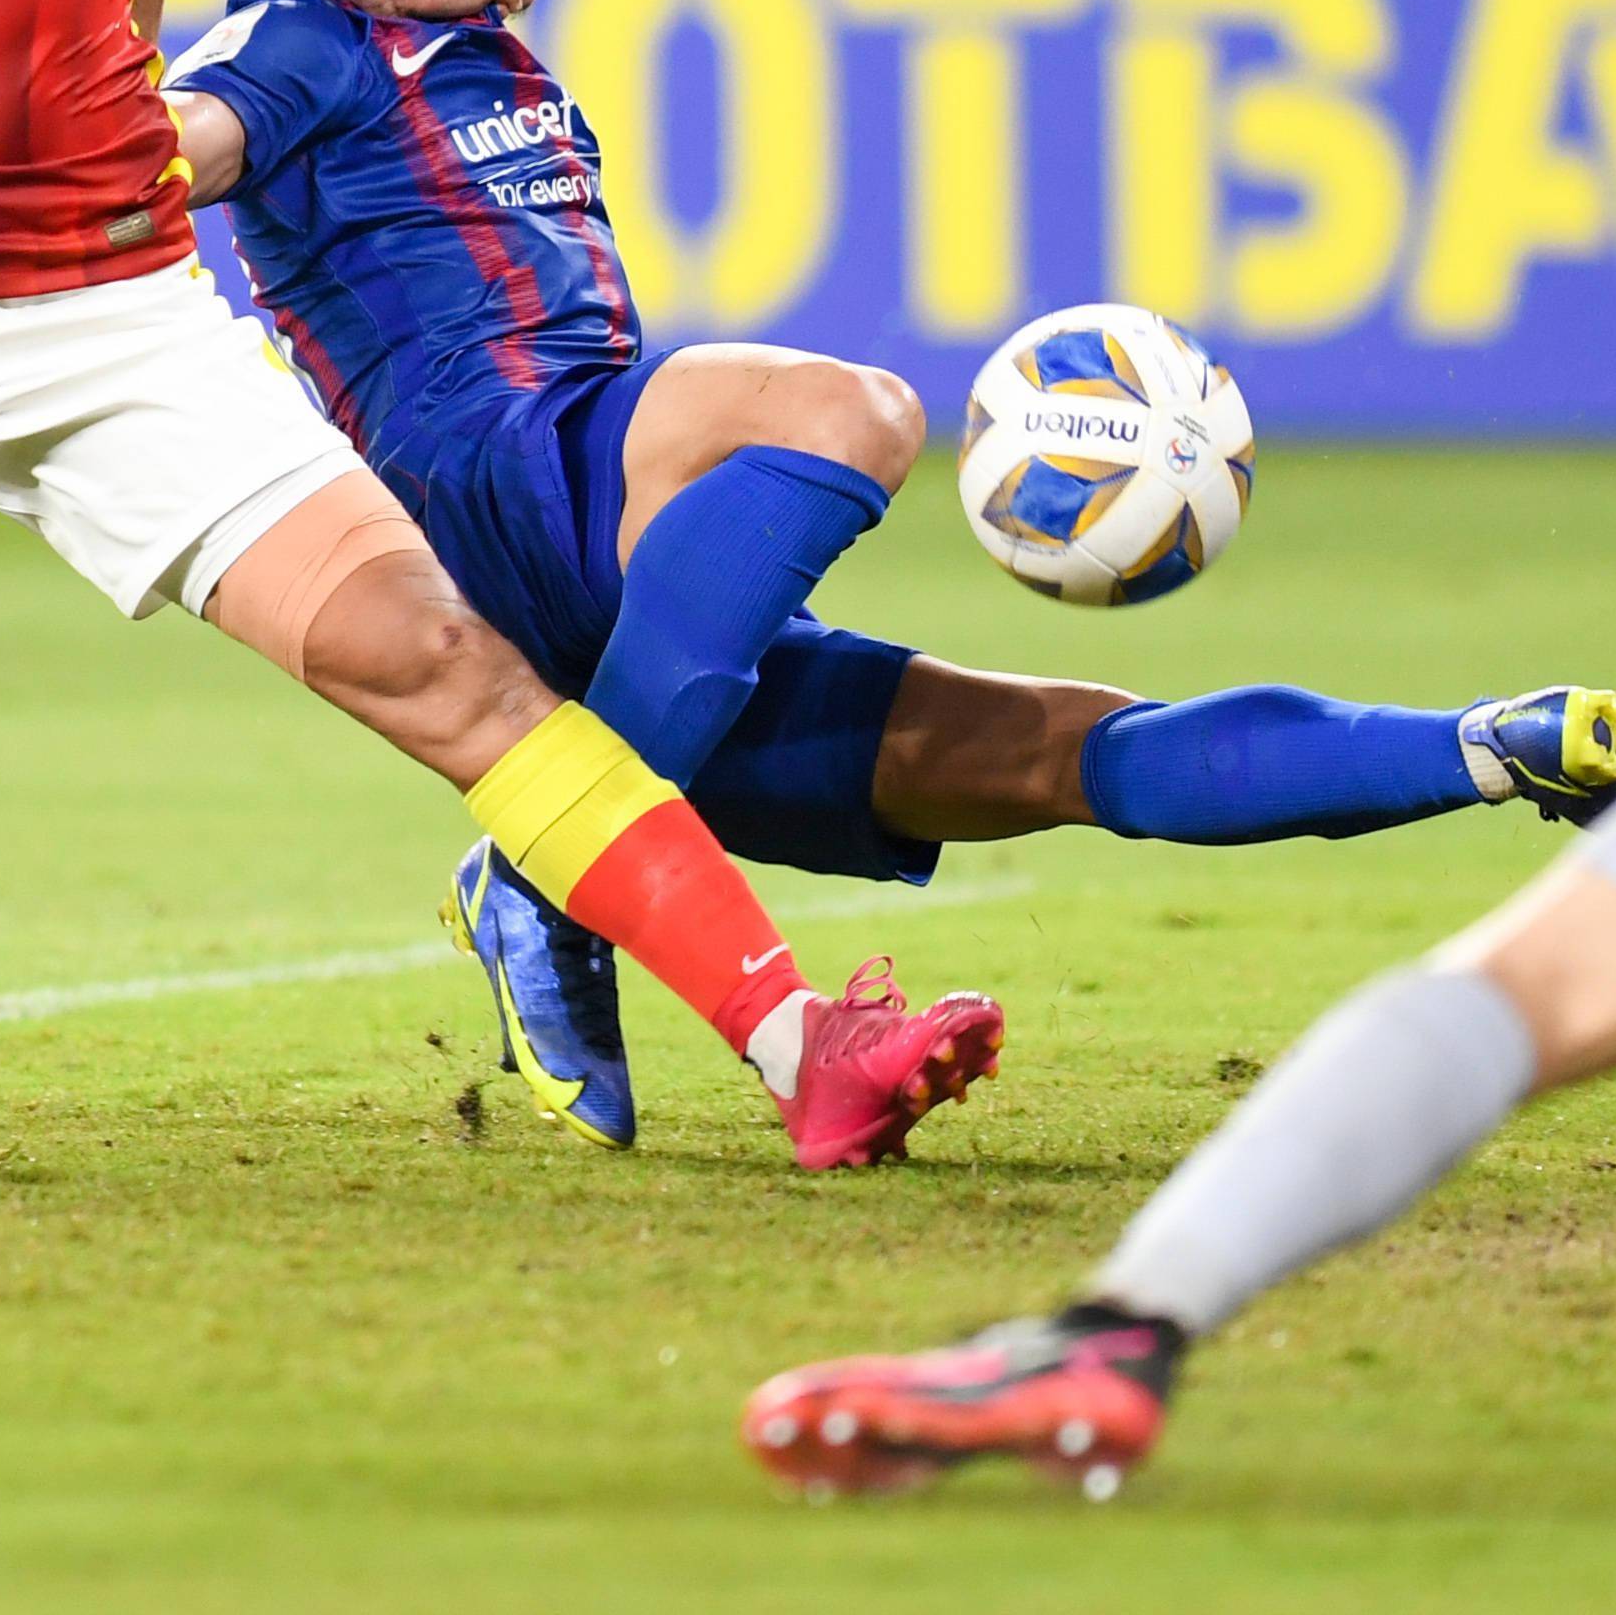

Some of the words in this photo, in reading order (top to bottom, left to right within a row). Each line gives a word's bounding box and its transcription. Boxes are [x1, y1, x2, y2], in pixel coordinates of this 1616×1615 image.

[450, 86, 575, 163] unicef
[487, 182, 526, 208] for
[529, 174, 593, 208] every
[1025, 411, 1140, 443] molten
